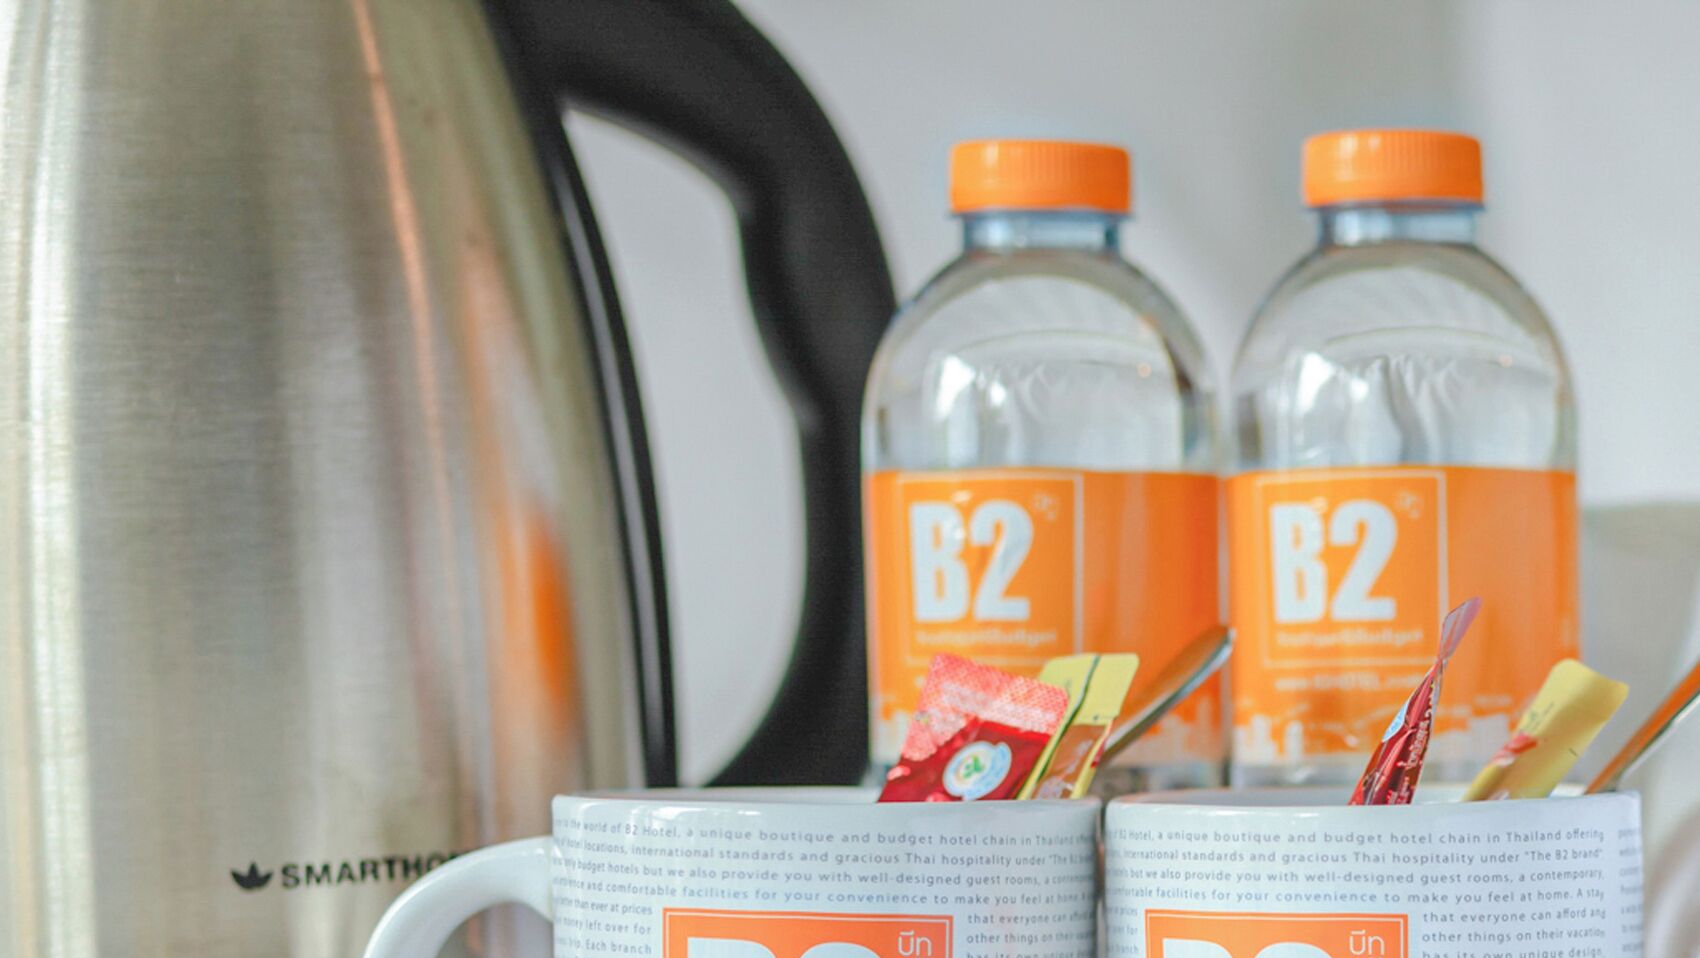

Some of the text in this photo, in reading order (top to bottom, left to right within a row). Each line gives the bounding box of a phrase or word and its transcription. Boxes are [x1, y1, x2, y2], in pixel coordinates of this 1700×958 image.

[910, 499, 1034, 623] B2
[1270, 499, 1397, 623] B2
[700, 829, 752, 840] unique
[760, 830, 834, 843] boutique
[841, 833, 870, 843] and
[878, 832, 933, 846] budget
[940, 834, 976, 845] hotel
[982, 835, 1016, 846] chain
[1021, 836, 1032, 845] in
[1167, 828, 1604, 845] unique boutique and budget hotel chain in Thailand offering
[631, 845, 1045, 867] international standards and gracious Thai hospitality under
[1182, 849, 1568, 866] standards and gracious Thai hospitality under B2
[607, 863, 639, 875] hotels
[643, 865, 663, 876] but
[667, 869, 685, 877] we
[689, 867, 716, 879] also
[722, 870, 778, 883] provide
[785, 872, 812, 882] you
[819, 872, 852, 882] with
[858, 872, 961, 887] well-designed
[966, 875, 1000, 887] guest
[1146, 868, 1513, 886] we also provide you with well-designed guest rooms,
[606, 883, 1041, 906] comfortable facilities for your convenience to make you feel
[1157, 888, 1206, 899] facilities
[1212, 889, 1230, 900] for
[1237, 891, 1268, 902] your
[1276, 891, 1377, 902] convenience
[1385, 893, 1400, 902] to
[1408, 892, 1449, 903] make
[1455, 894, 1482, 905] you
[1488, 890, 1514, 902] feel
[1520, 892, 1532, 902] at
[1537, 890, 1573, 900] home.
[622, 904, 653, 915] prices
[1423, 907, 1586, 925] that everyone can afford
[968, 914, 1049, 926] that everyone
[633, 923, 651, 935] for
[1422, 930, 1564, 945] other things on their
[967, 933, 1038, 945] other things
[611, 942, 652, 954] branch
